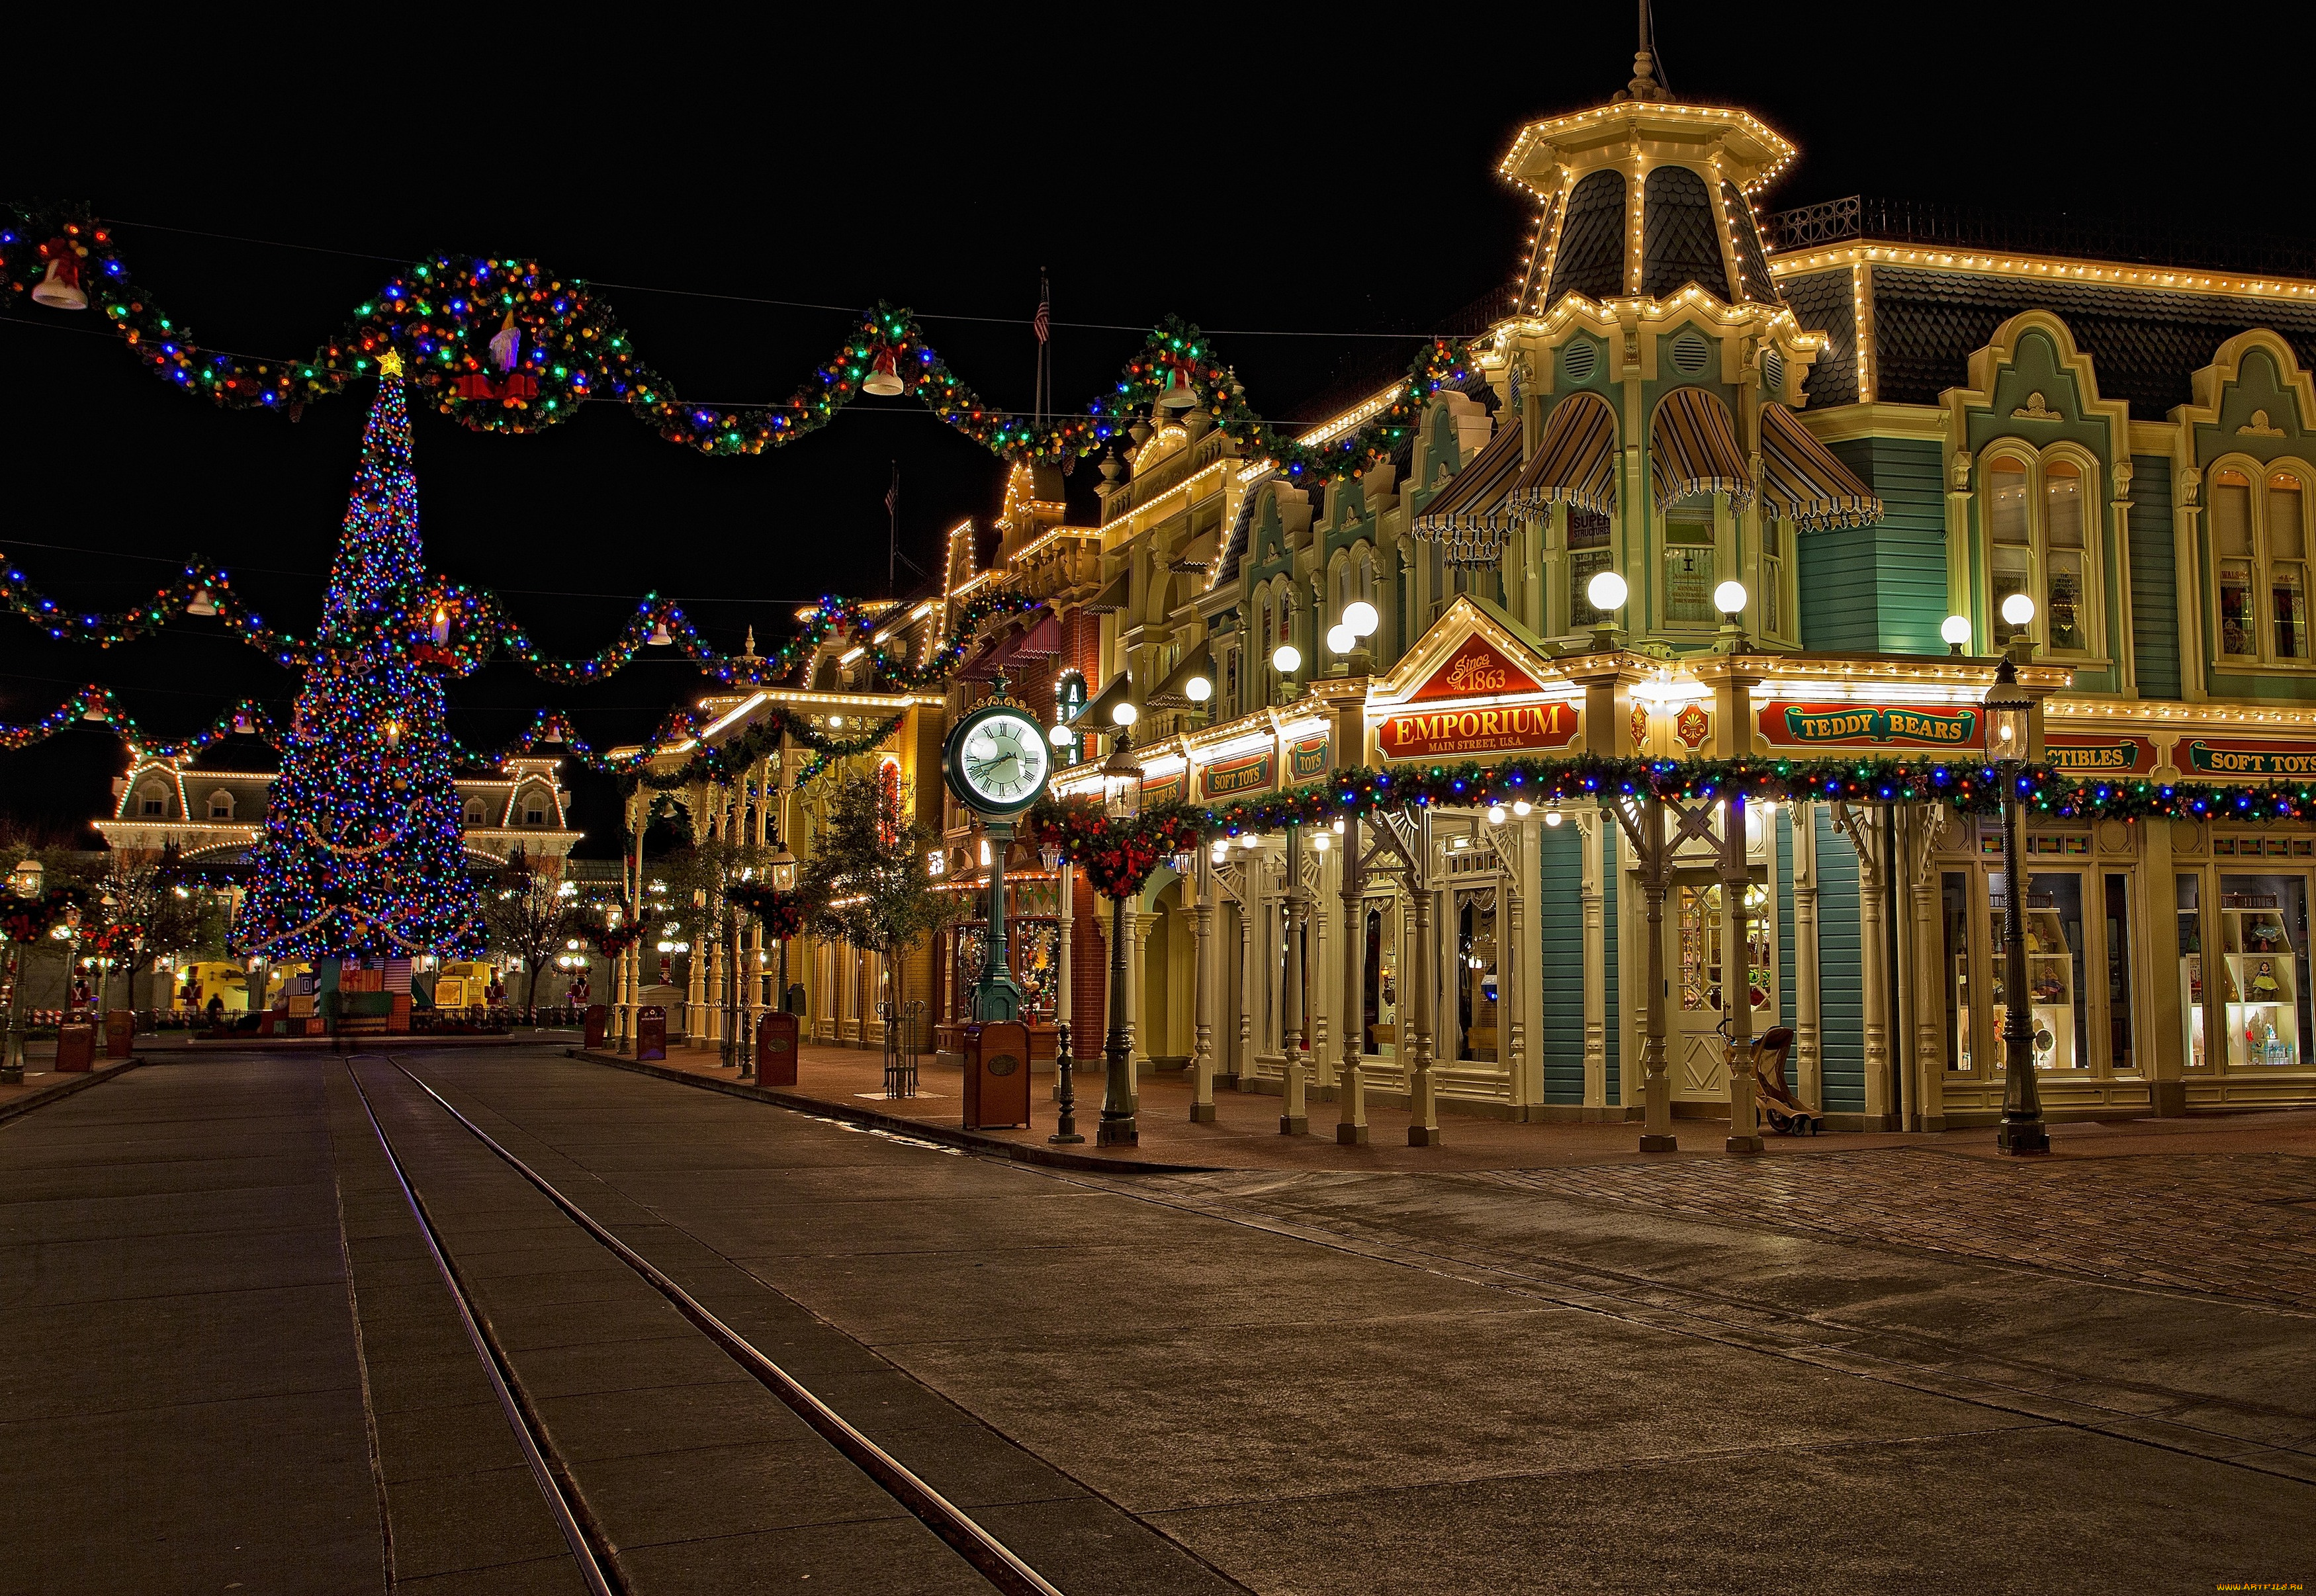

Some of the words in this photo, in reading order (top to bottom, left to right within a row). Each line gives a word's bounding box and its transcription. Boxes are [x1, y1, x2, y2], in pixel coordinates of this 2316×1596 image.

[1574, 513, 1611, 529] SUPER
[1574, 526, 1610, 537] STRUCTURES
[1450, 654, 1491, 682] Since
[1467, 669, 1506, 691] 1863
[1394, 705, 1561, 746] EMPORIUM
[1802, 714, 1873, 736] TEDDY
[1889, 714, 1962, 740] BEARS
[1428, 740, 1455, 752] MAIN
[1457, 738, 1496, 750] STREET,
[1499, 736, 1524, 747] U.S.A.
[1300, 752, 1321, 772] TOYS
[2046, 749, 2124, 766] CTIBLES
[2211, 752, 2264, 771] SOFT
[1214, 772, 1236, 790] SOFT
[1237, 766, 1260, 785] TOYS
